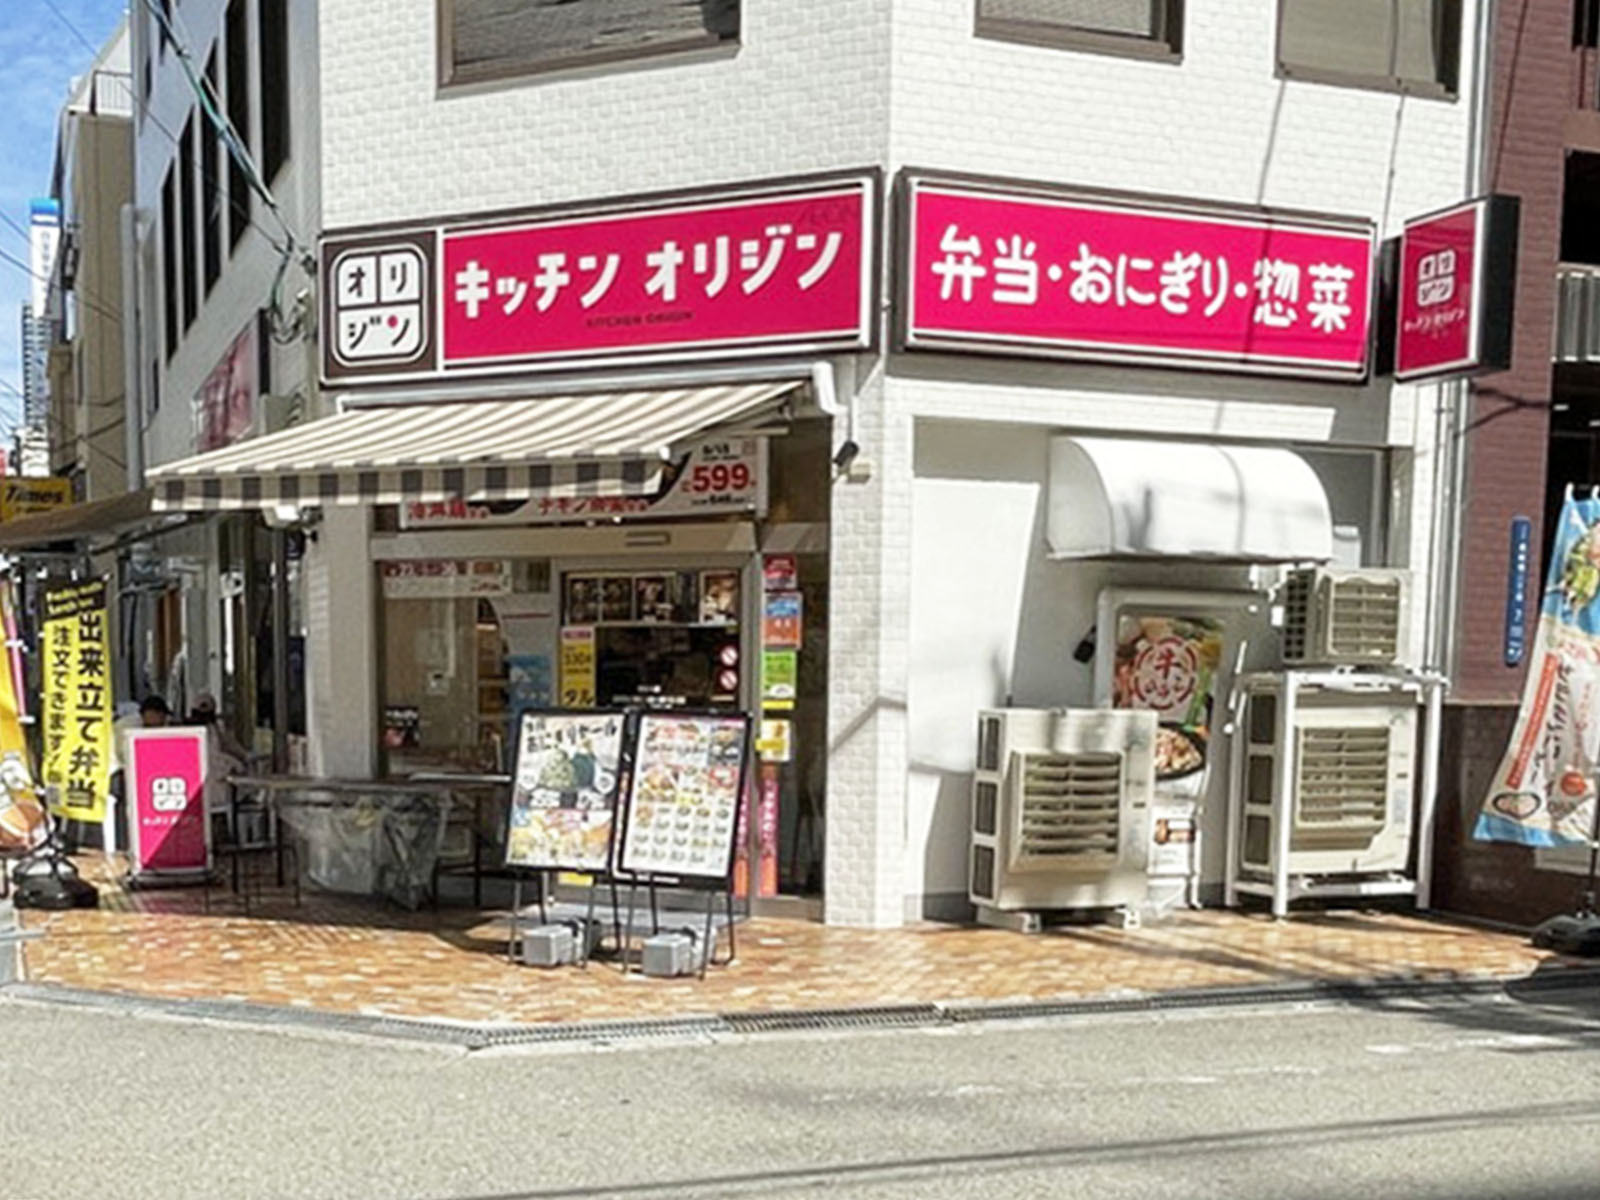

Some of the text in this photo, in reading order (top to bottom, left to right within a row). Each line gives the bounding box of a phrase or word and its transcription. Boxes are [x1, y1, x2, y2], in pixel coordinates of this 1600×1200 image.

[455, 223, 842, 318] キッチン オリジン
[931, 224, 1354, 333] 弁当・おにぎり・惣菜
[66, 612, 104, 809] 出来立て弁当
